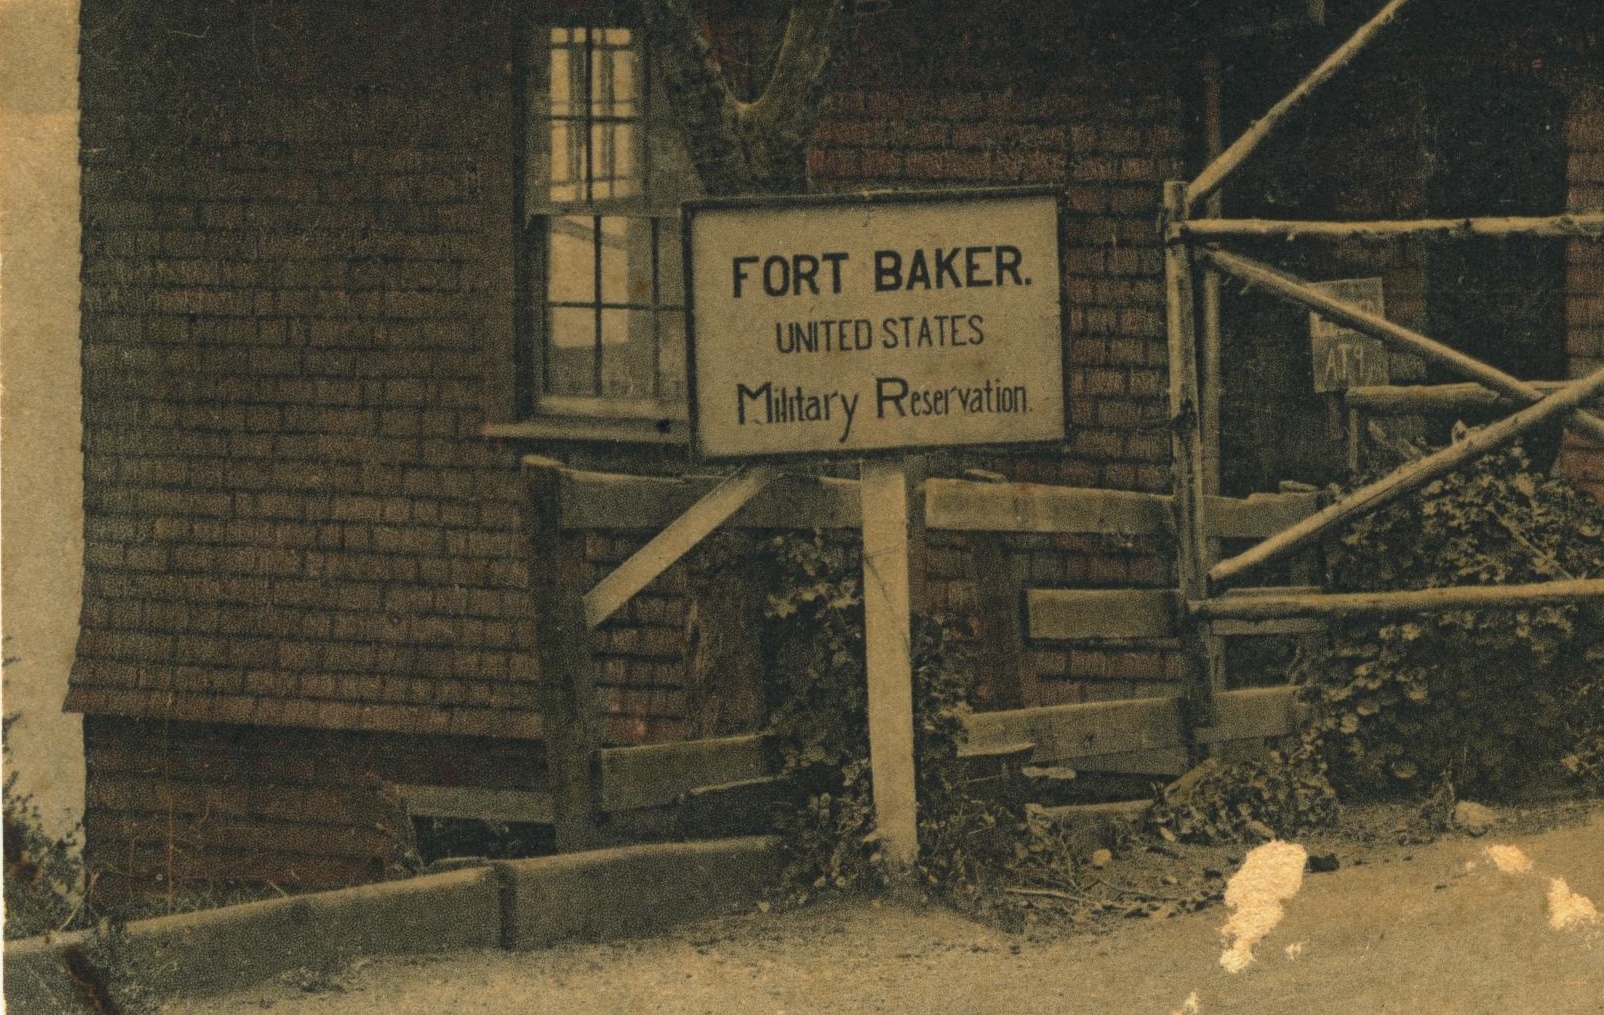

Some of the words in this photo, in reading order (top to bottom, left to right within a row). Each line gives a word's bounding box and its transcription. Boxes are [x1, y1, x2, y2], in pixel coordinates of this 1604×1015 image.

[731, 251, 850, 299] FORT
[872, 244, 1033, 293] BAKER.
[775, 317, 873, 354] UNITED
[882, 314, 985, 350] STATES
[736, 380, 860, 444] Military
